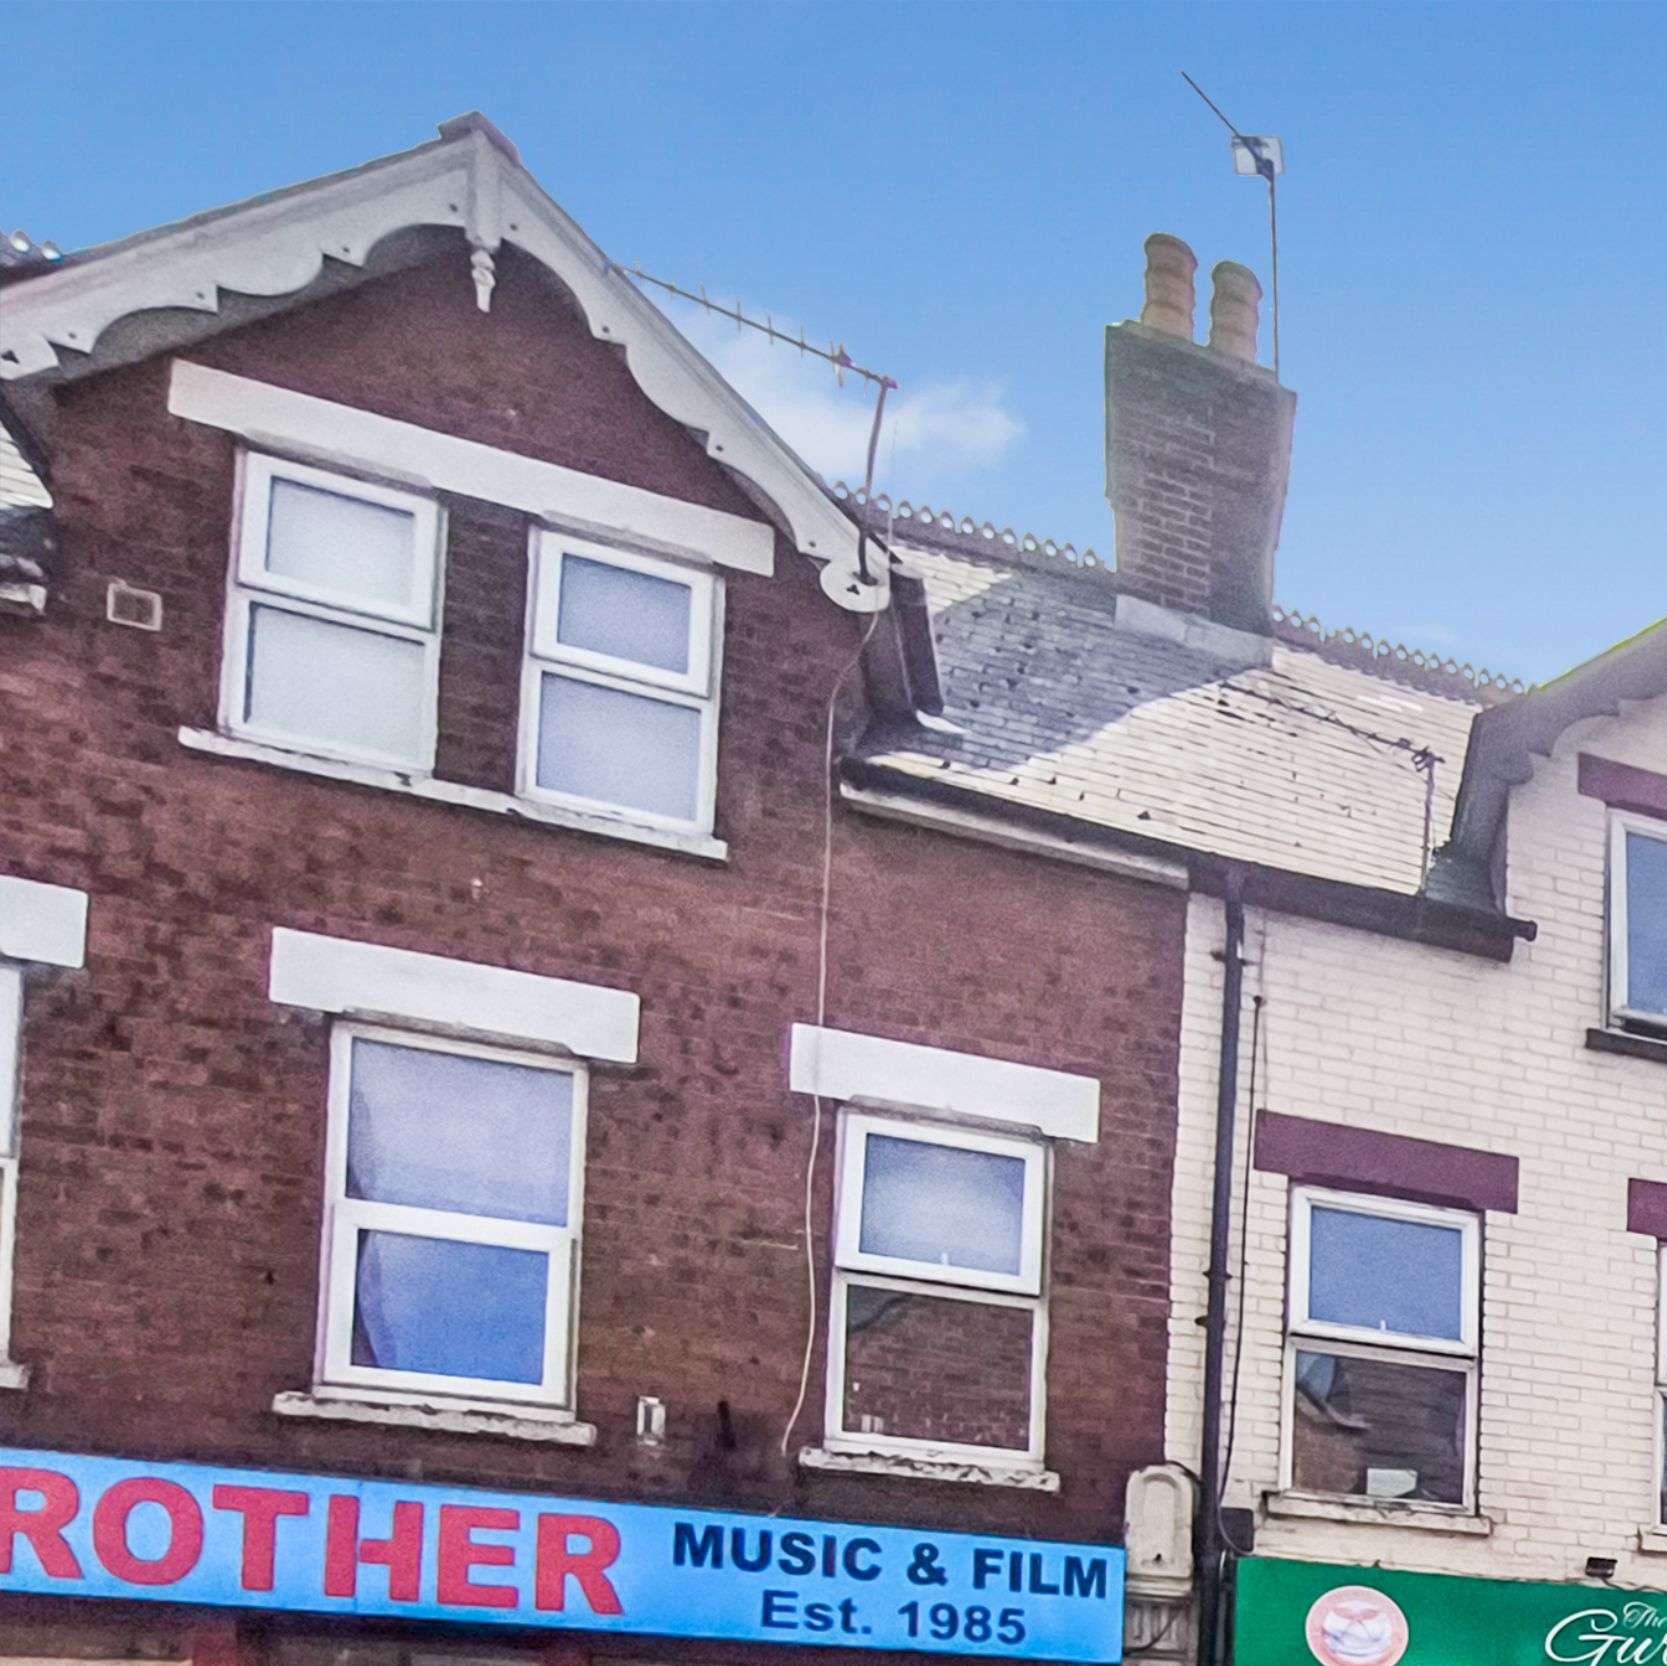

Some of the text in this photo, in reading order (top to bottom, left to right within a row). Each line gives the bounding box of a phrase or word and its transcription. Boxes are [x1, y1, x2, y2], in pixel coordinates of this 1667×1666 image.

[0, 1466, 625, 1617] ROTHER
[673, 1522, 1108, 1599] MUSIC & FILM
[761, 1589, 1027, 1645] Est. 1985
